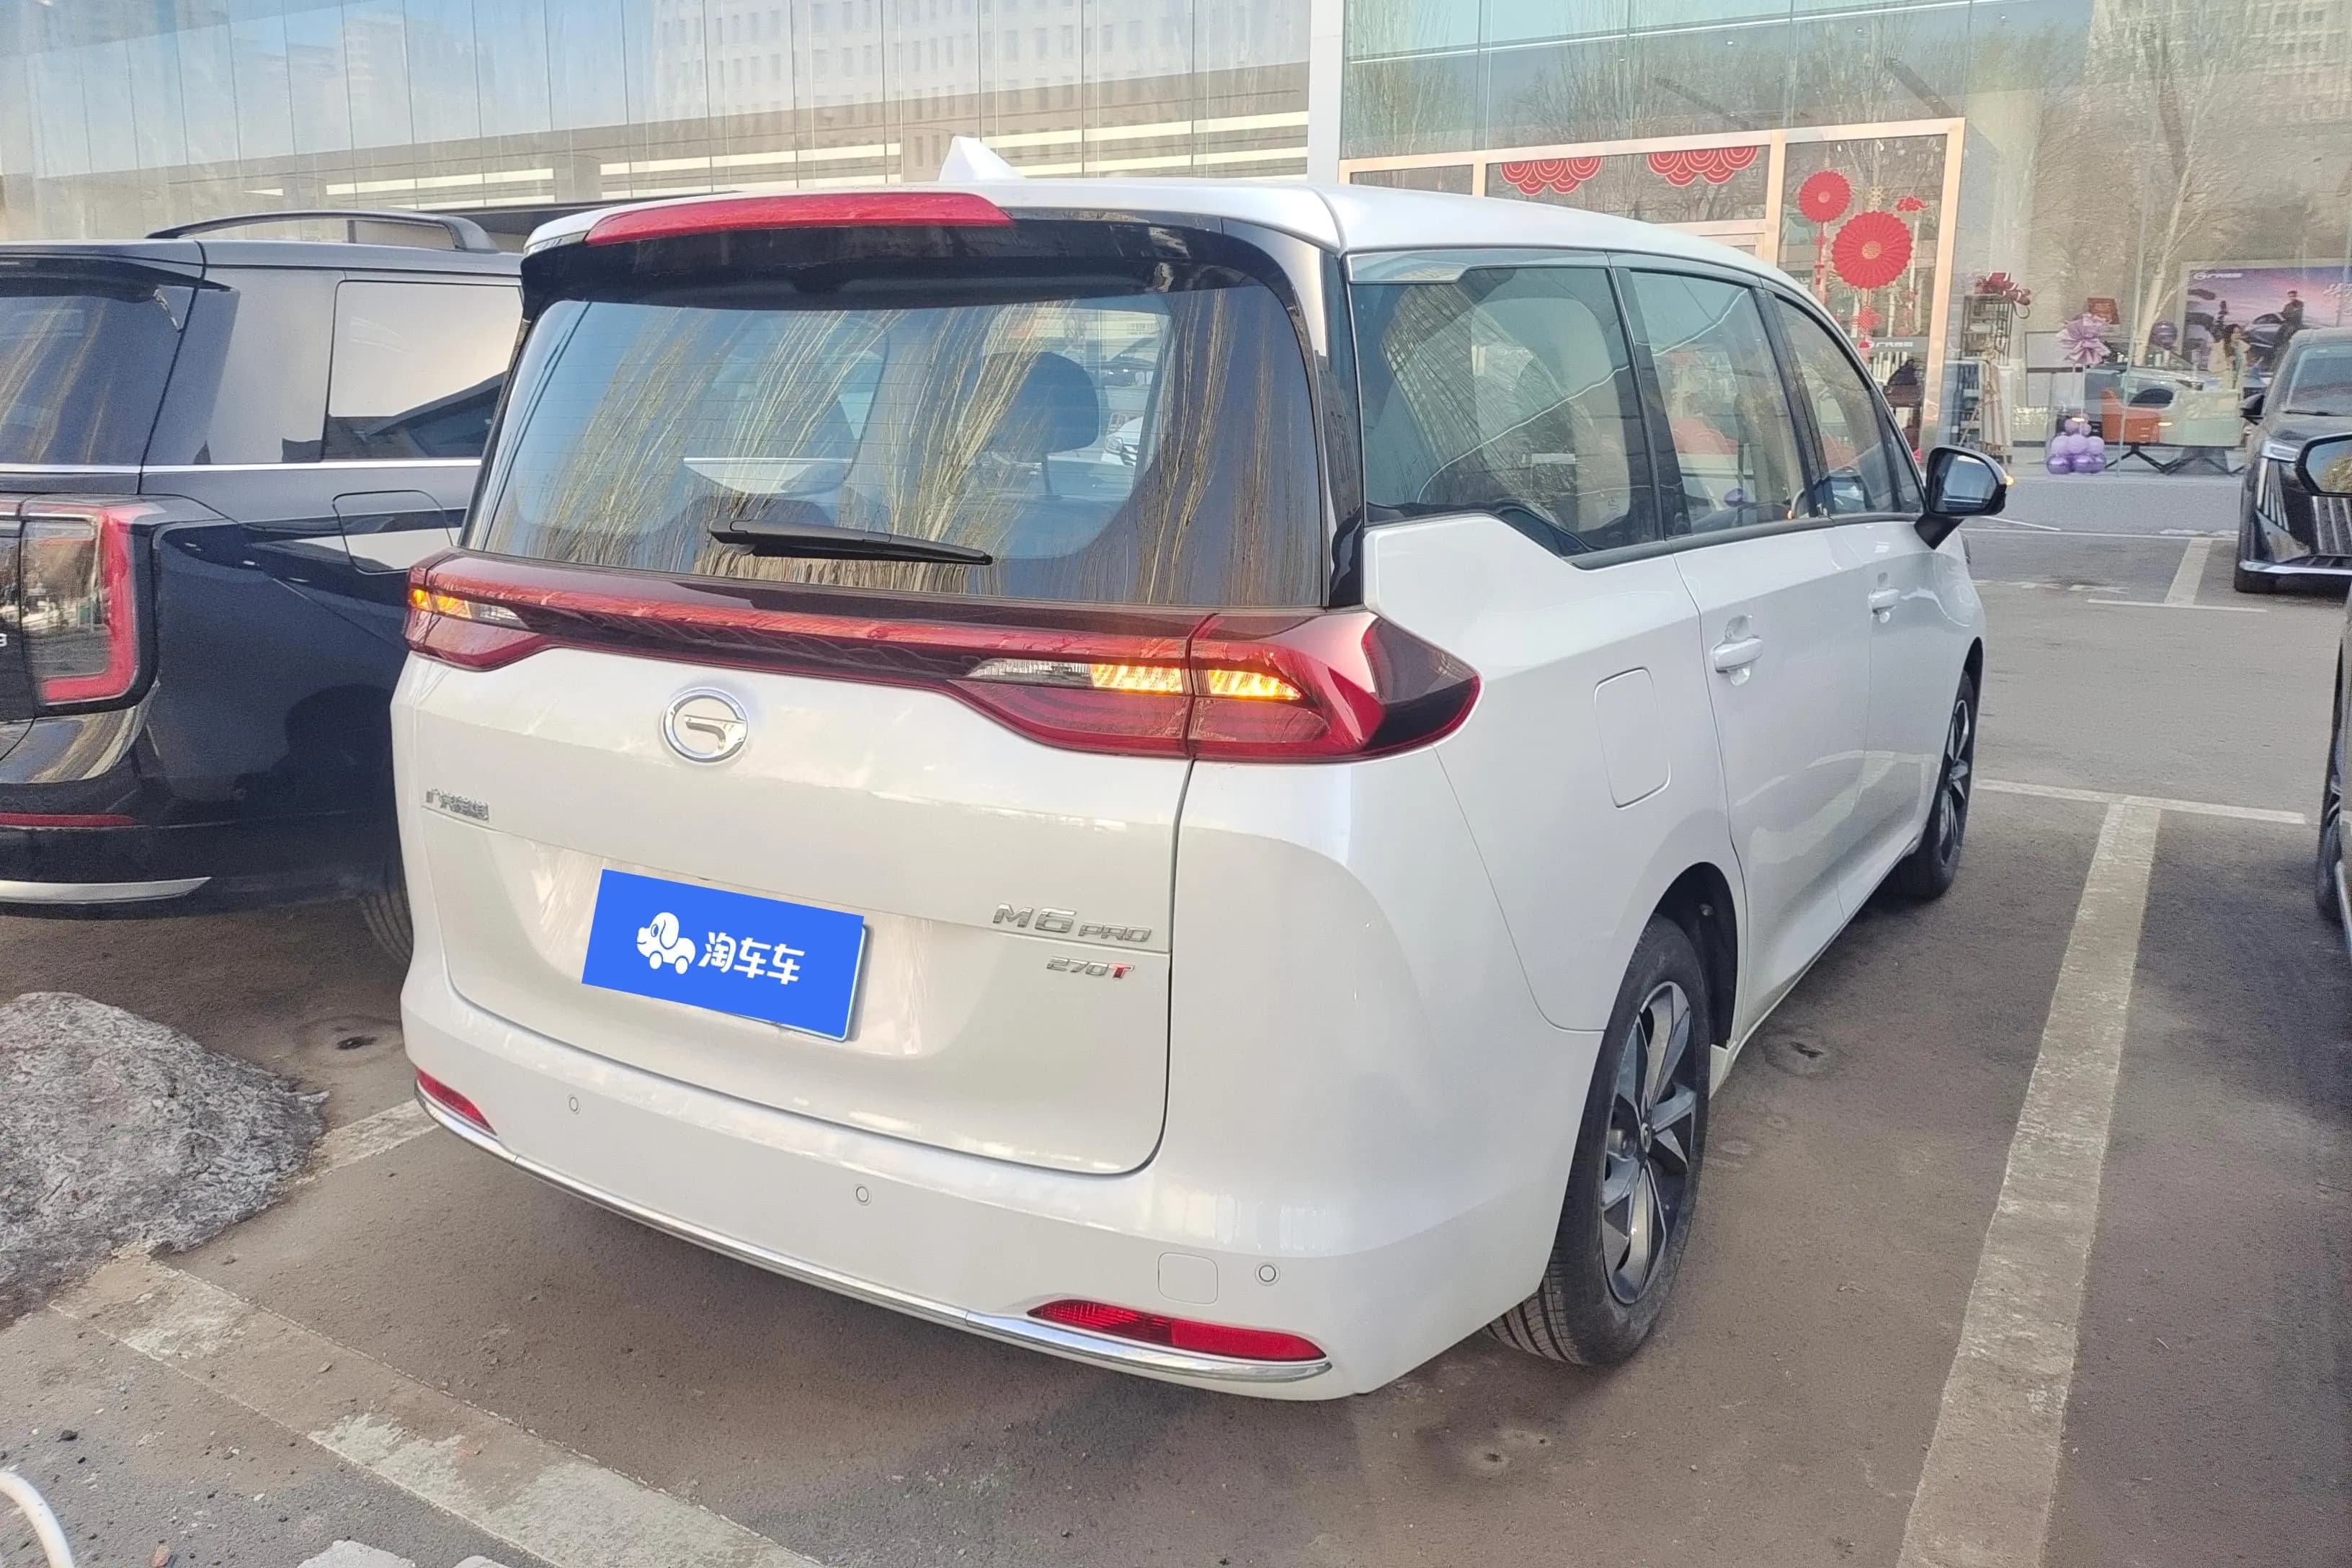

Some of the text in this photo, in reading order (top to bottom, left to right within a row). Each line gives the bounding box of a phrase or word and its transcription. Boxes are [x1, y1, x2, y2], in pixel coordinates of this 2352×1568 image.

[992, 903, 1152, 943] M6 PRO
[1046, 956, 1135, 979] 270T
